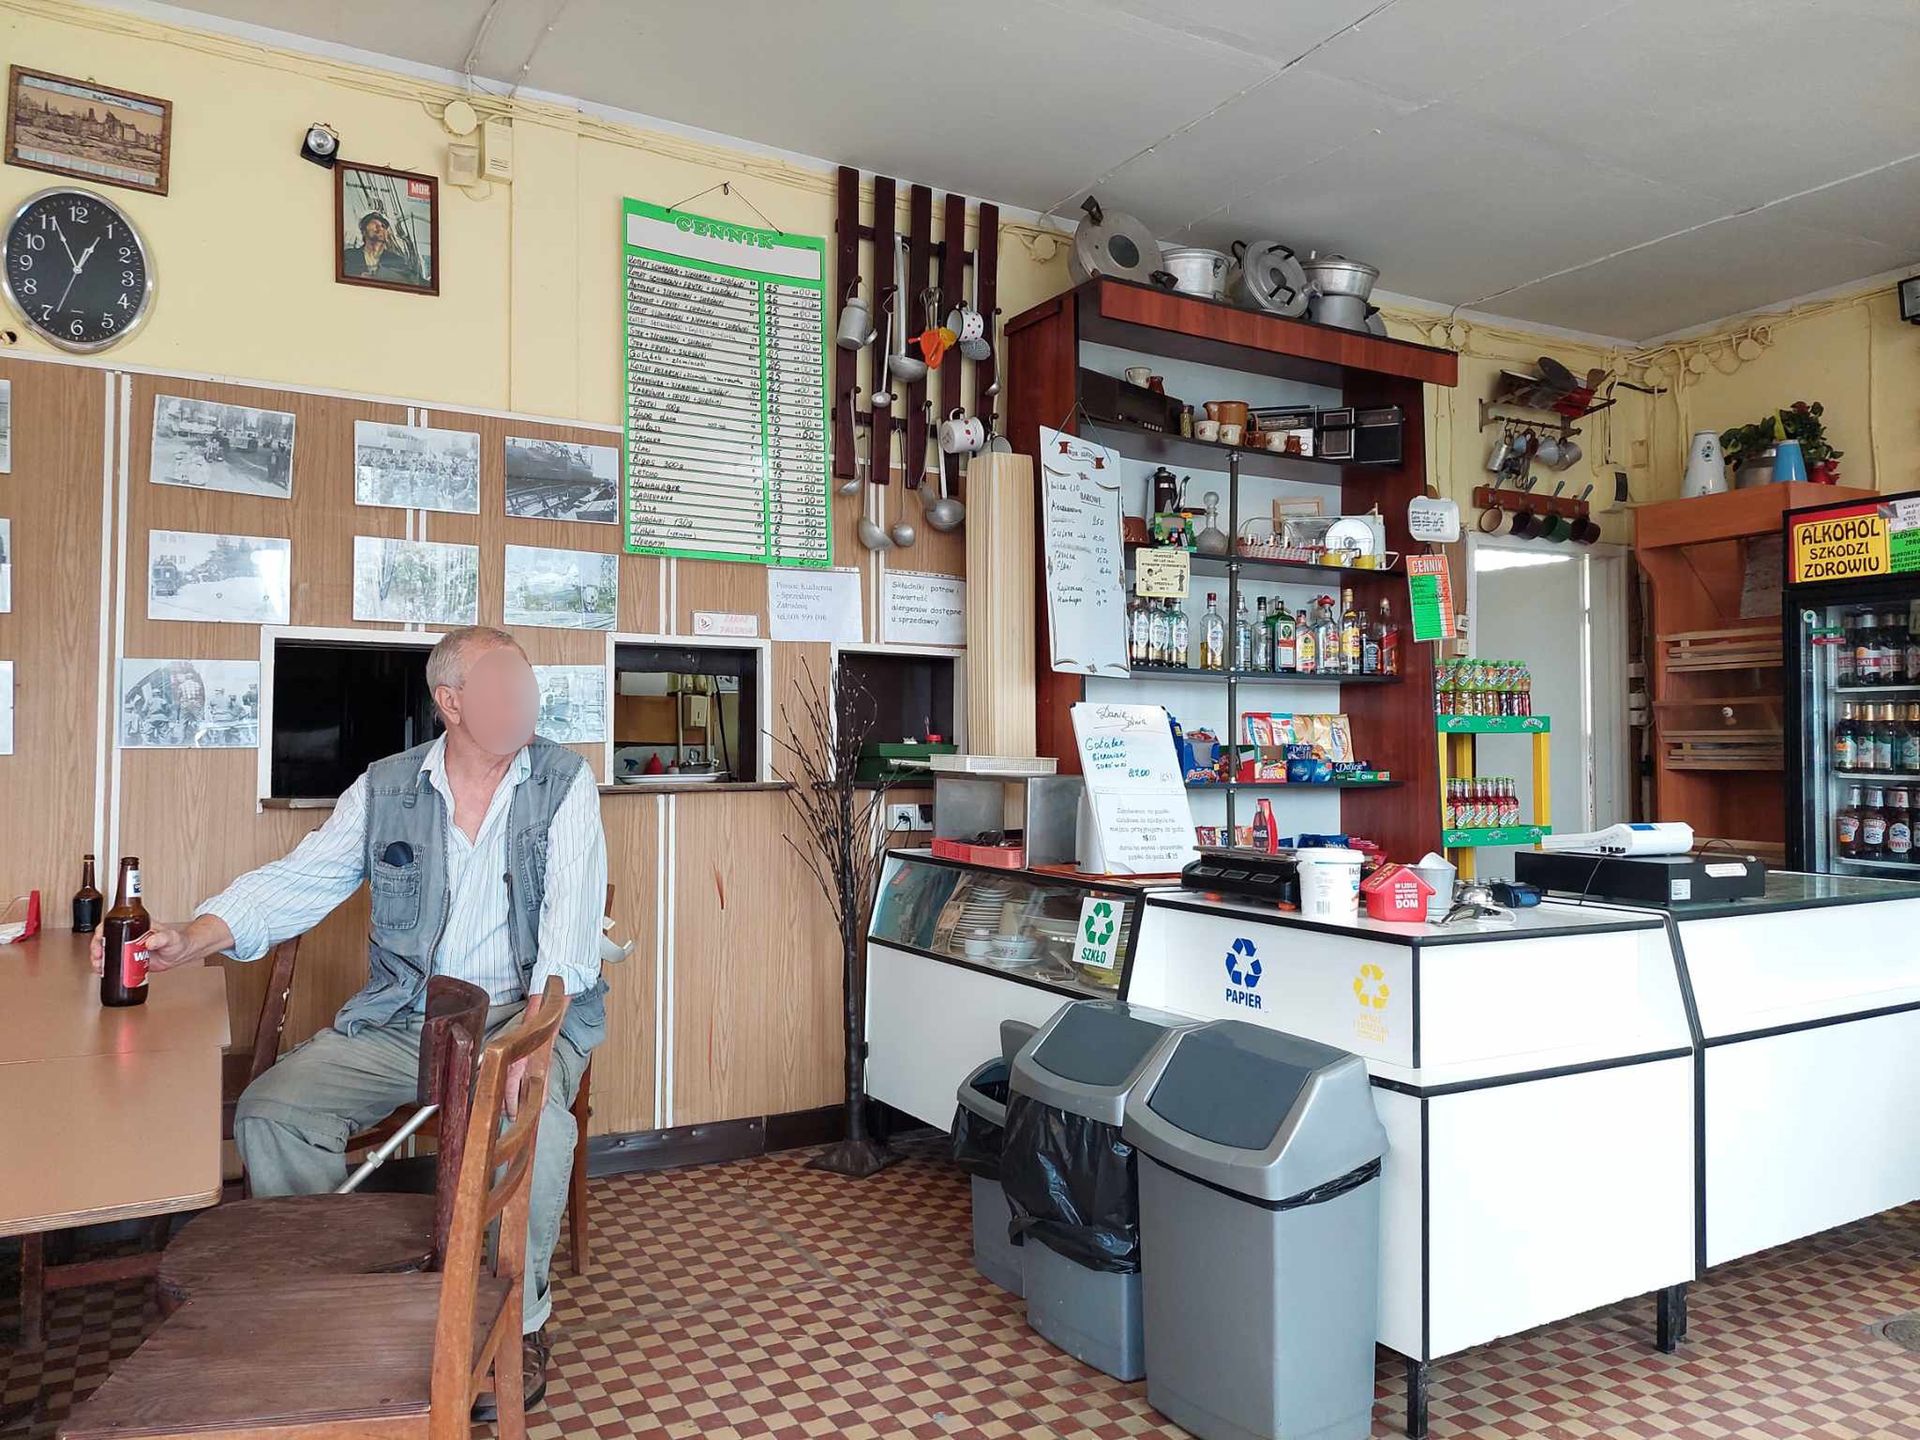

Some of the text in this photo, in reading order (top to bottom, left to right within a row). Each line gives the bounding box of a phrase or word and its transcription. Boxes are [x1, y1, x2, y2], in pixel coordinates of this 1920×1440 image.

[69, 206, 89, 223] 12
[39, 214, 56, 231] 11
[107, 225, 116, 239] 1
[675, 216, 774, 250] CENNIK
[25, 233, 45, 250] 10
[20, 254, 33, 271] 9
[119, 247, 132, 263] 2
[24, 278, 37, 294] 8
[122, 271, 134, 286] 3
[117, 293, 131, 309] 4
[41, 304, 53, 321] 7
[70, 320, 84, 335] 6
[101, 313, 114, 328] 5
[774, 425, 780, 436] 9
[772, 449, 781, 458] 15
[772, 460, 782, 469] 16
[1802, 519, 1880, 545] ALKOHOL
[775, 537, 781, 545] 6
[1810, 542, 1869, 559] SZKODZI
[1412, 559, 1444, 573] CENNIK
[1804, 557, 1879, 578] ZDROWIU
[891, 581, 925, 591] Składniki
[892, 593, 928, 602] zawartość
[891, 604, 962, 616] alergenów dostępne
[898, 616, 940, 627] sprzedawcy
[1395, 899, 1418, 909] DOM
[1082, 947, 1107, 964] SZKŁO
[1225, 988, 1262, 1009] PAPIER
